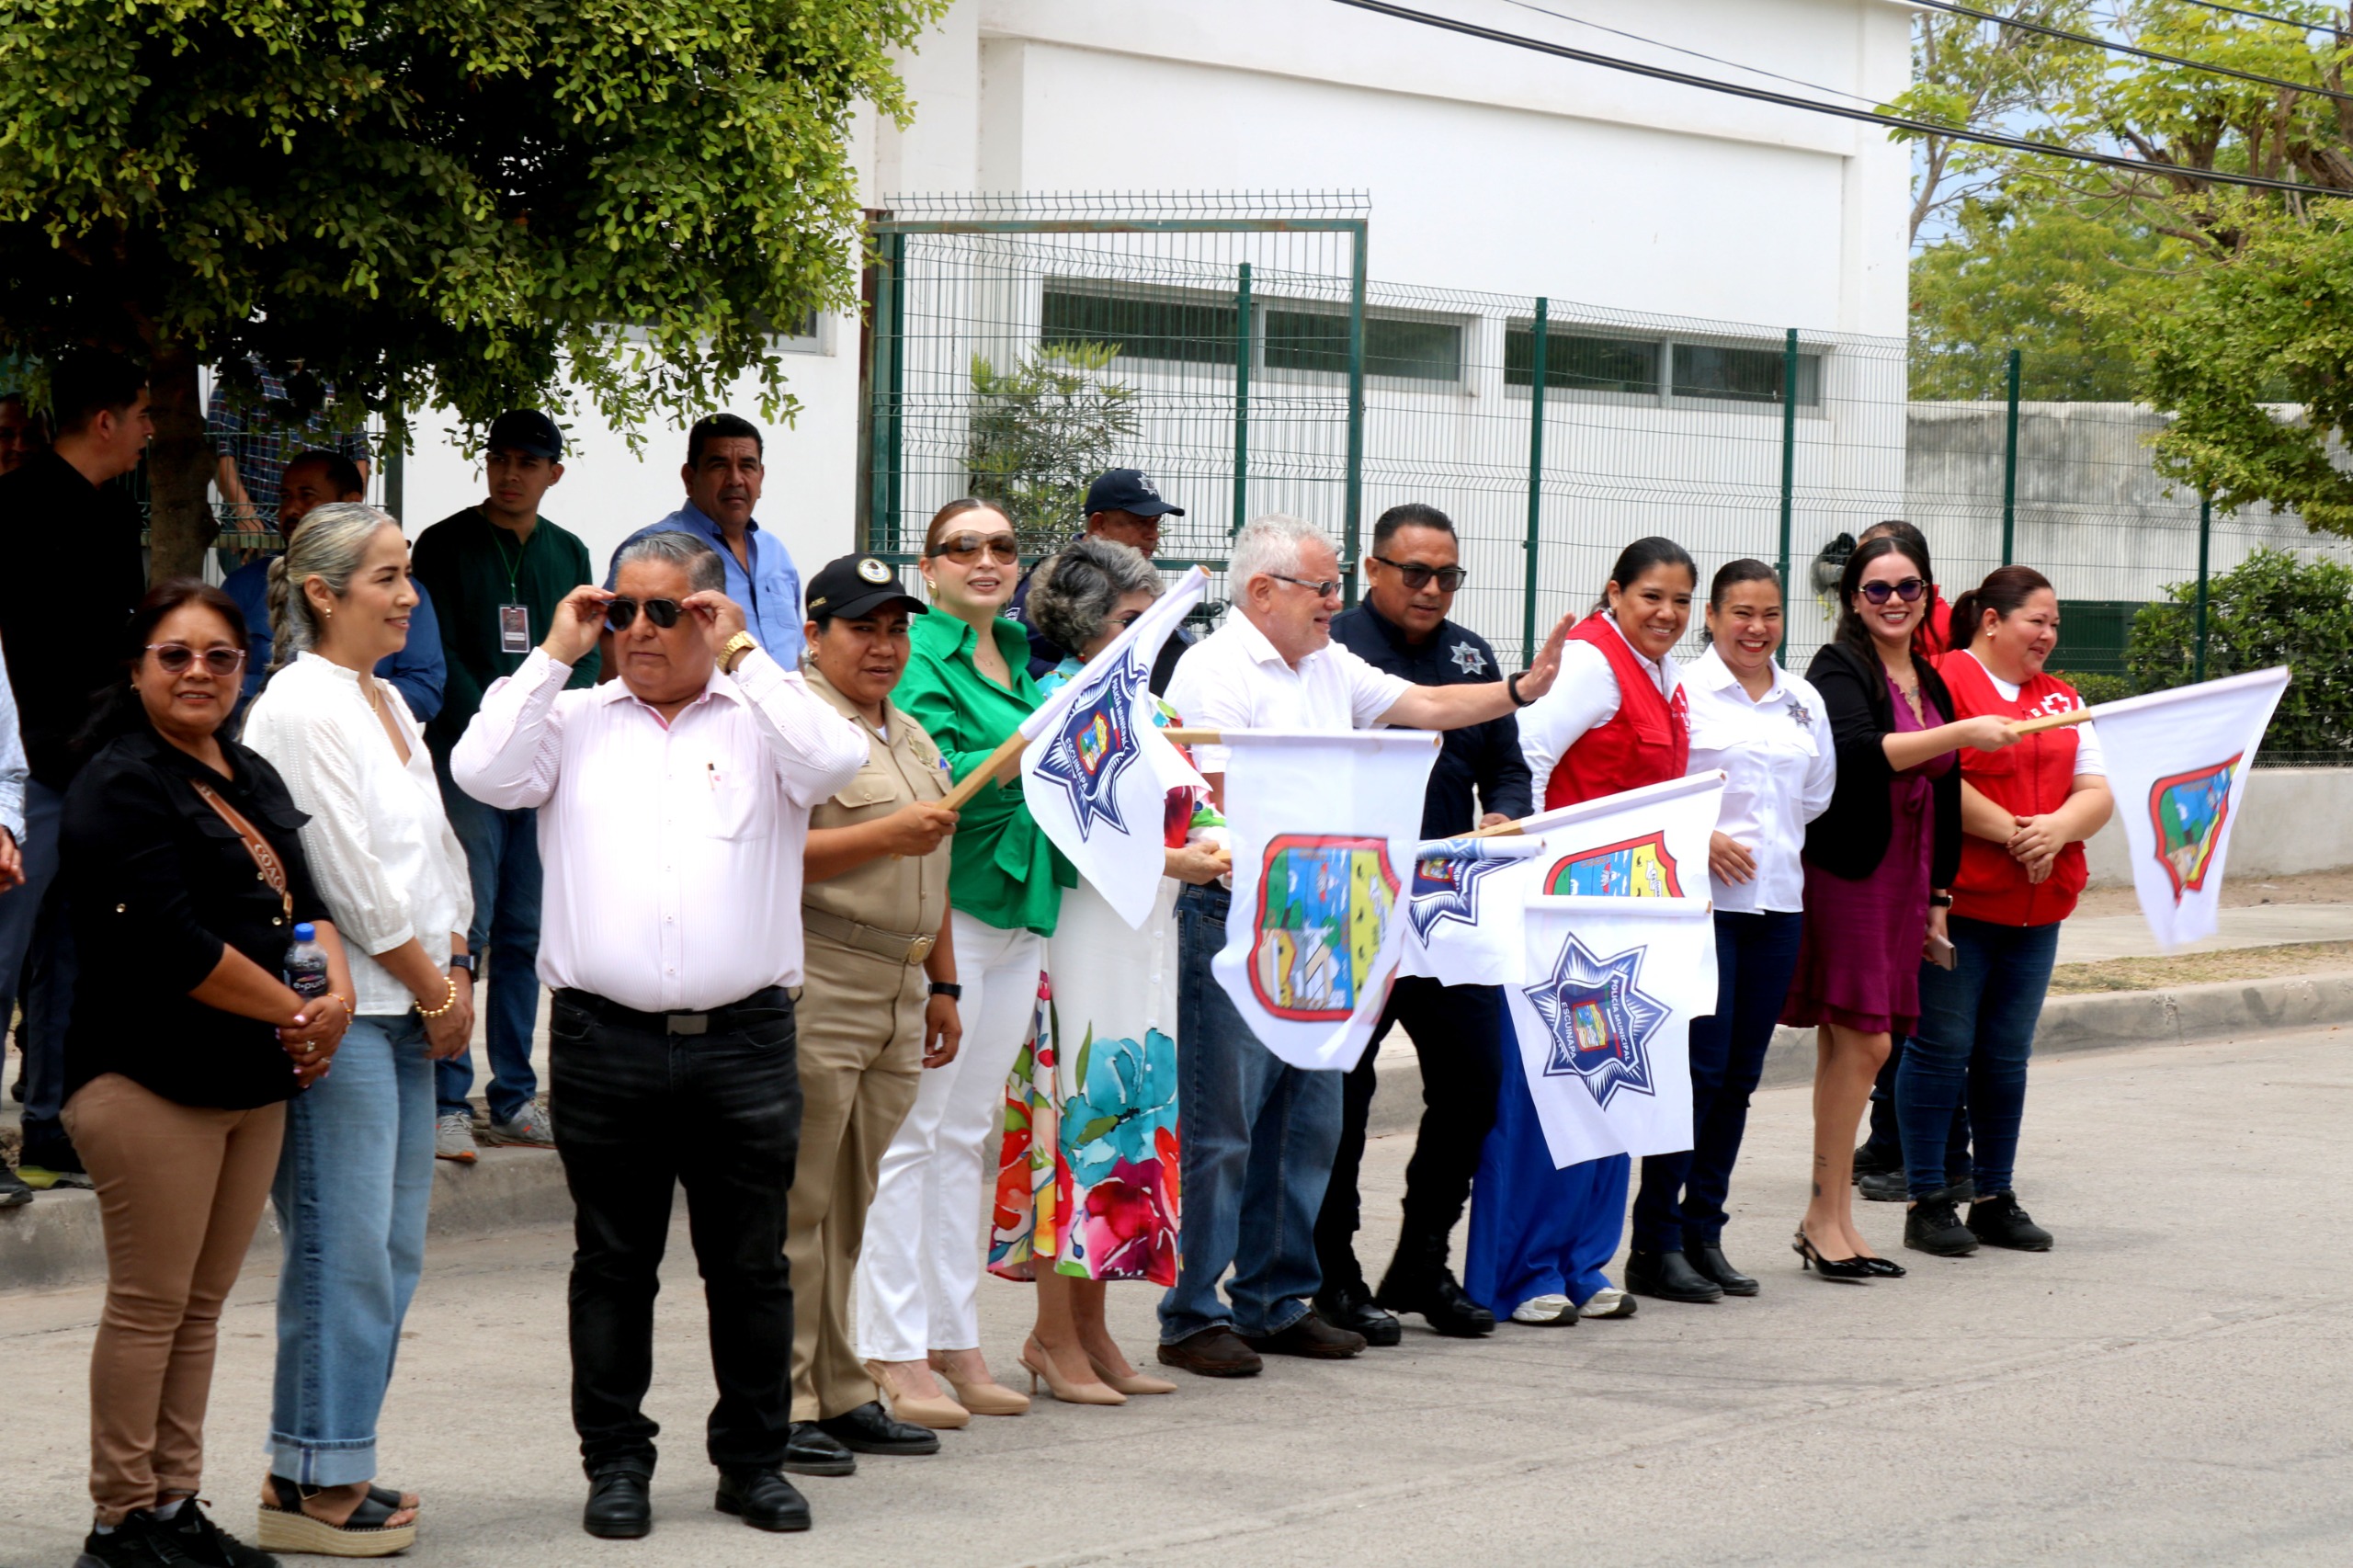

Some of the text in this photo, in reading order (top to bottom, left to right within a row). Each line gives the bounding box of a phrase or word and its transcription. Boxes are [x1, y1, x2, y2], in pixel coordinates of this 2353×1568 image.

[1111, 677, 1127, 748] POLICÍA MUNICIPAL
[1064, 737, 1089, 791] ESCUINAPA
[1561, 1002, 1577, 1059] ESCUINAPA
[1610, 979, 1631, 1062] POLICÍA MUNICIPAL
